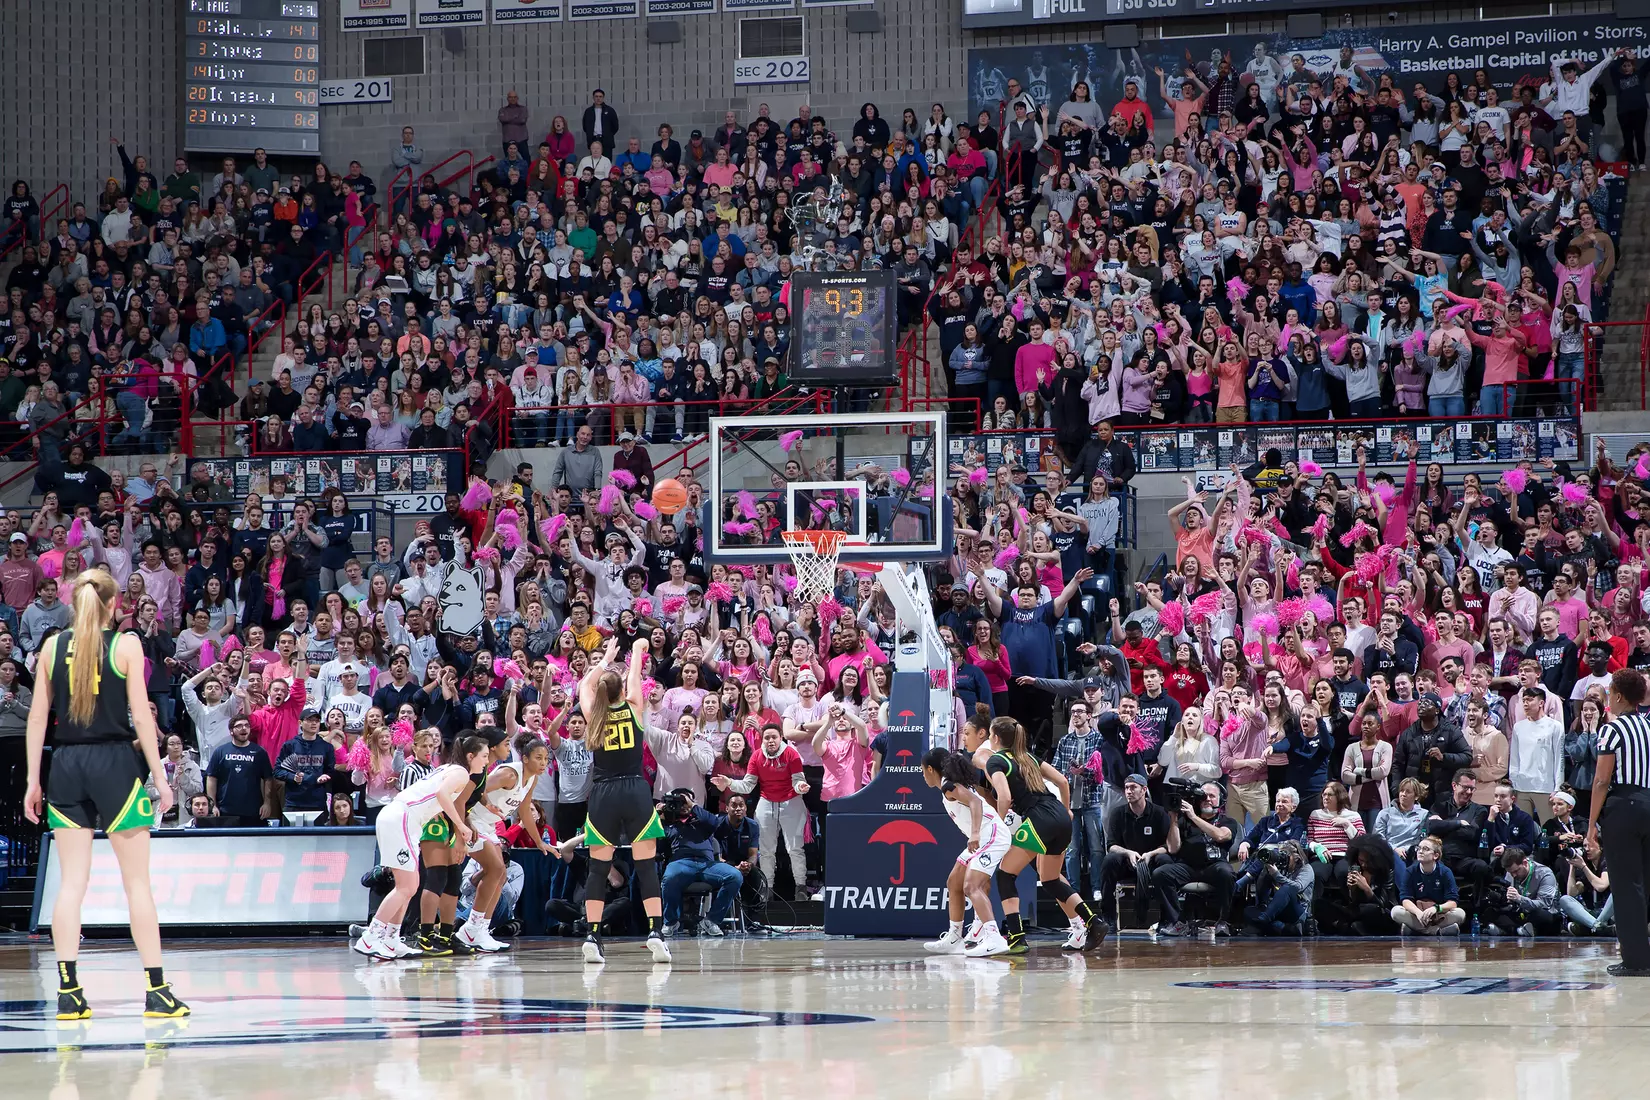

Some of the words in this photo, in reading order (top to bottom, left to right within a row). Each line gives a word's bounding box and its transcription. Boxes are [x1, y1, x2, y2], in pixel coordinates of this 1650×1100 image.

[420, 14, 460, 22] 1999-2000
[461, 12, 482, 20] TERM
[496, 10, 536, 18] 2001-2002
[344, 18, 384, 27] 1994-1995
[385, 17, 406, 25] TERM
[1379, 38, 1422, 53] Harry
[1428, 36, 1443, 50] A.
[1448, 32, 1510, 50] Gampel
[1515, 28, 1578, 45] Pavilion
[1594, 24, 1648, 40] Storrs,
[199, 43, 207, 56] 3
[1400, 54, 1484, 73] Basketball
[1487, 50, 1546, 71] Capital
[1549, 49, 1567, 62] of
[1570, 48, 1598, 63] the
[1601, 44, 1650, 61] Wld
[193, 66, 207, 77] 14
[736, 66, 760, 78] SEC
[766, 60, 808, 79] 202
[189, 87, 207, 100] 20
[321, 86, 345, 97] SEC
[354, 81, 390, 98] 201
[189, 109, 207, 122] 23
[825, 288, 863, 316] 9.3
[238, 462, 248, 471] 50
[273, 462, 283, 470] 21
[308, 461, 318, 469] 52
[1198, 475, 1226, 486] SEC
[386, 498, 411, 510] SEC
[416, 495, 446, 512] 20
[439, 533, 454, 541] UCO
[1476, 559, 1494, 571] UCO
[1482, 572, 1492, 587] 15
[1464, 599, 1483, 608] ONN
[306, 650, 333, 660] UCONN
[608, 710, 631, 720] NESCU
[1137, 708, 1169, 717] UCONN
[887, 725, 924, 733] TRAVELERS
[604, 720, 635, 752] 20
[225, 753, 255, 763] UCONN
[885, 765, 923, 773] TRAVELERS
[505, 797, 519, 808] UCO
[885, 803, 922, 811] TRAVELERS
